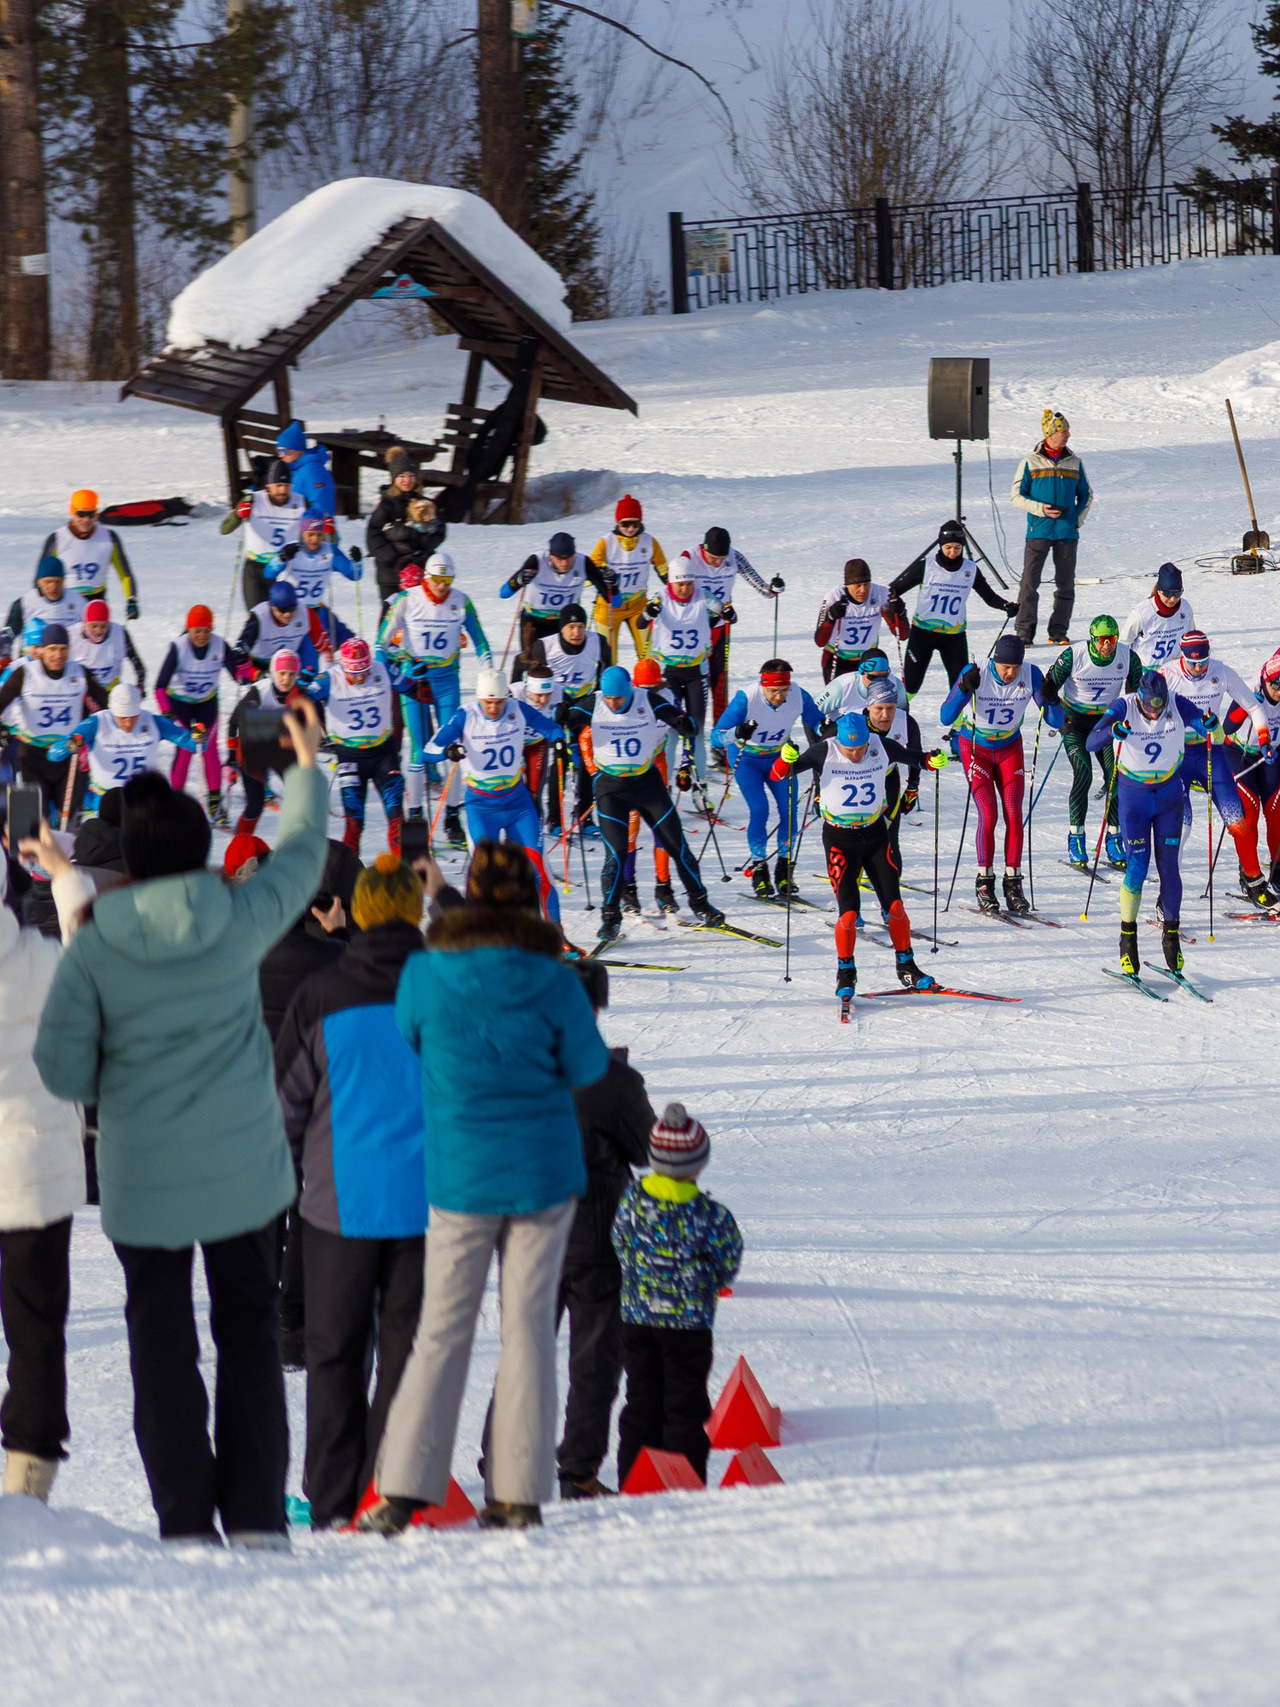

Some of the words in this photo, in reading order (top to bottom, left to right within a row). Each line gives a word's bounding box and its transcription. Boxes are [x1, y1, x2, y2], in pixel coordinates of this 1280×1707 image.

[270, 528, 286, 547] 5
[72, 562, 100, 580] 19
[294, 580, 324, 599] 56
[539, 592, 577, 606] 101
[930, 594, 962, 615] 110
[421, 631, 448, 650] 16
[670, 629, 699, 650] 53
[844, 625, 873, 645] 37
[1151, 639, 1177, 660] 59
[1091, 687, 1106, 702] 7
[38, 706, 73, 728] 34
[347, 706, 382, 731] 33
[984, 708, 1015, 725] 13
[757, 729, 785, 743] 14
[610, 737, 642, 757] 10
[1144, 742, 1162, 764] 9
[111, 756, 148, 780] 25
[481, 745, 515, 771] 20
[841, 782, 877, 807] 23
[1127, 837, 1146, 846] KAZ
